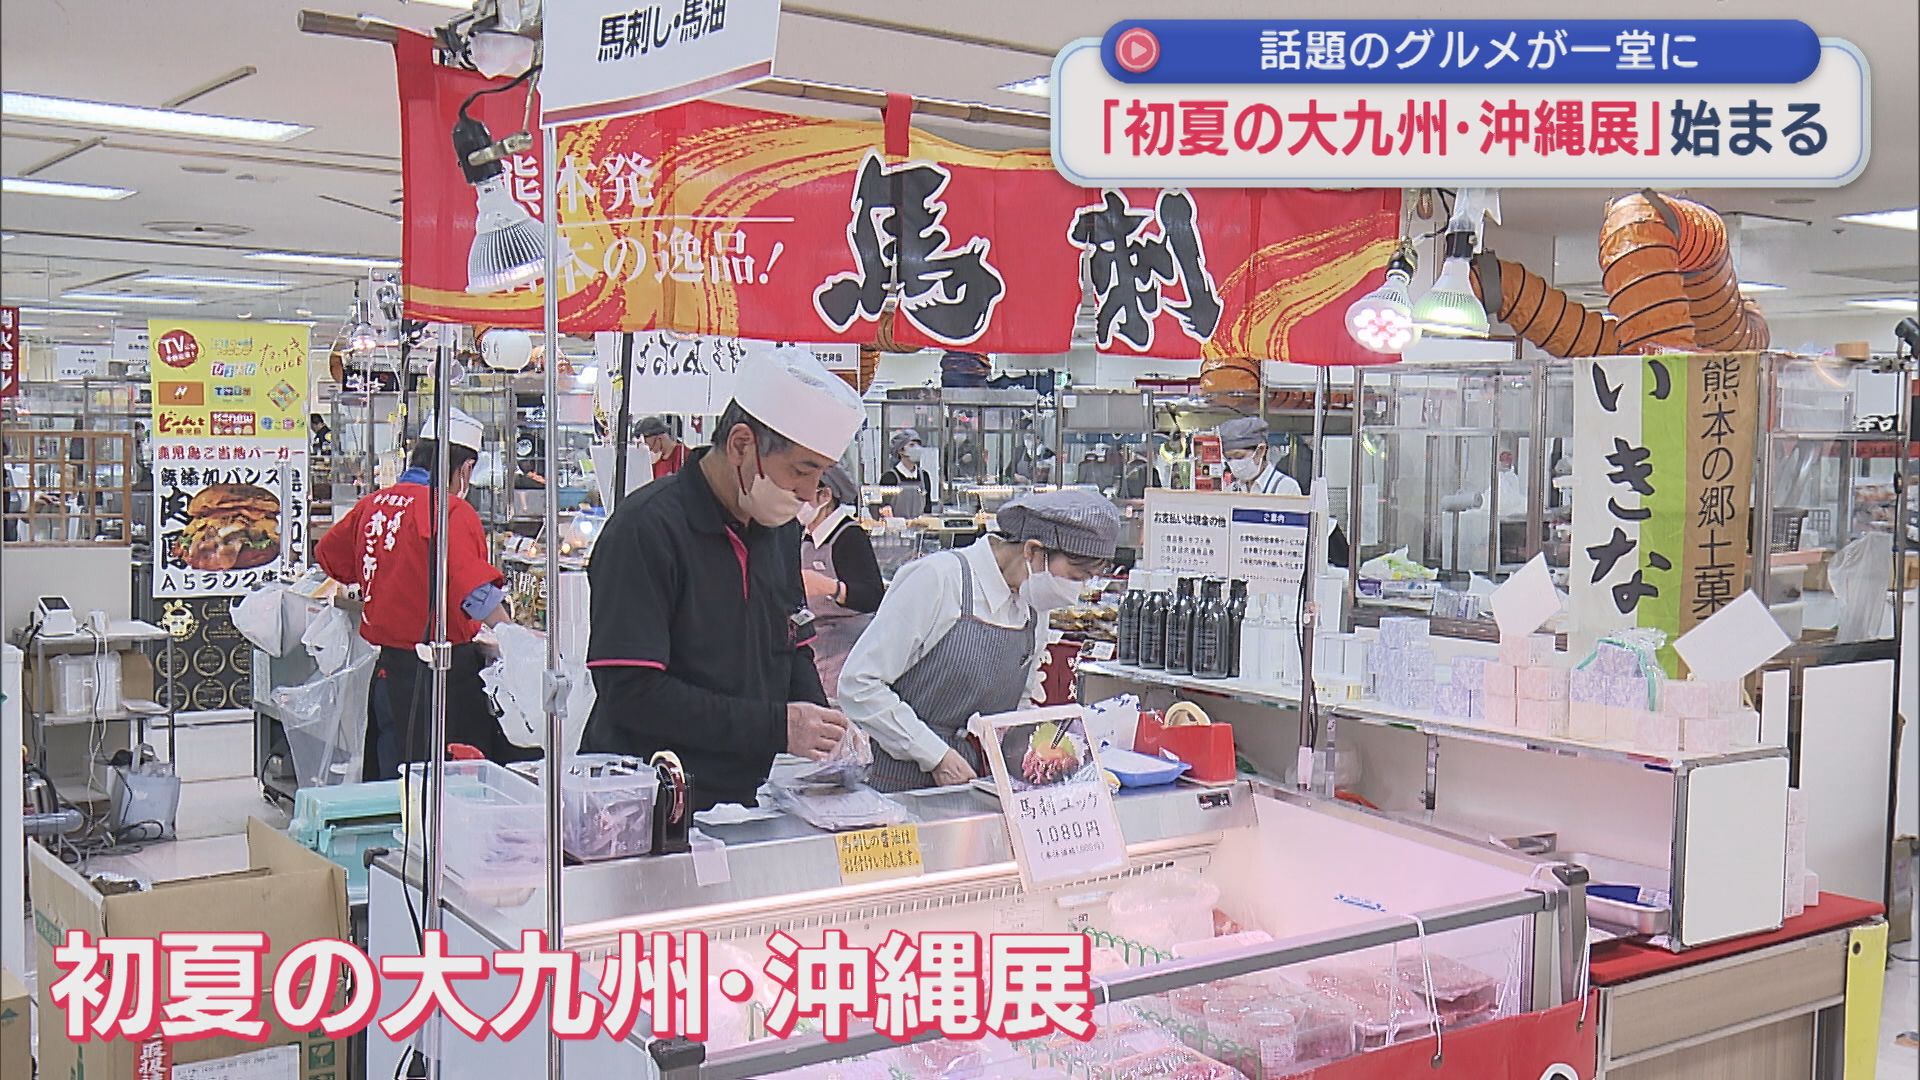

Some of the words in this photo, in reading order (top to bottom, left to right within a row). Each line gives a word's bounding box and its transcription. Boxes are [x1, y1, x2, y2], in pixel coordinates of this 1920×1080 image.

[598, 0, 726, 62] 馬刺し・馬油
[501, 152, 655, 215] 熊本発
[505, 228, 785, 293] 本の逸品!
[812, 150, 1226, 352] 馬刺
[158, 445, 305, 460] 鹿児島ご当地バーガー
[1585, 360, 1672, 614] いきな
[1693, 357, 1740, 620] 熊本の郷土菓
[1154, 512, 1226, 528] お支払いは現金の他
[1263, 513, 1286, 524] ご案内
[1036, 819, 1101, 846] 1,080円
